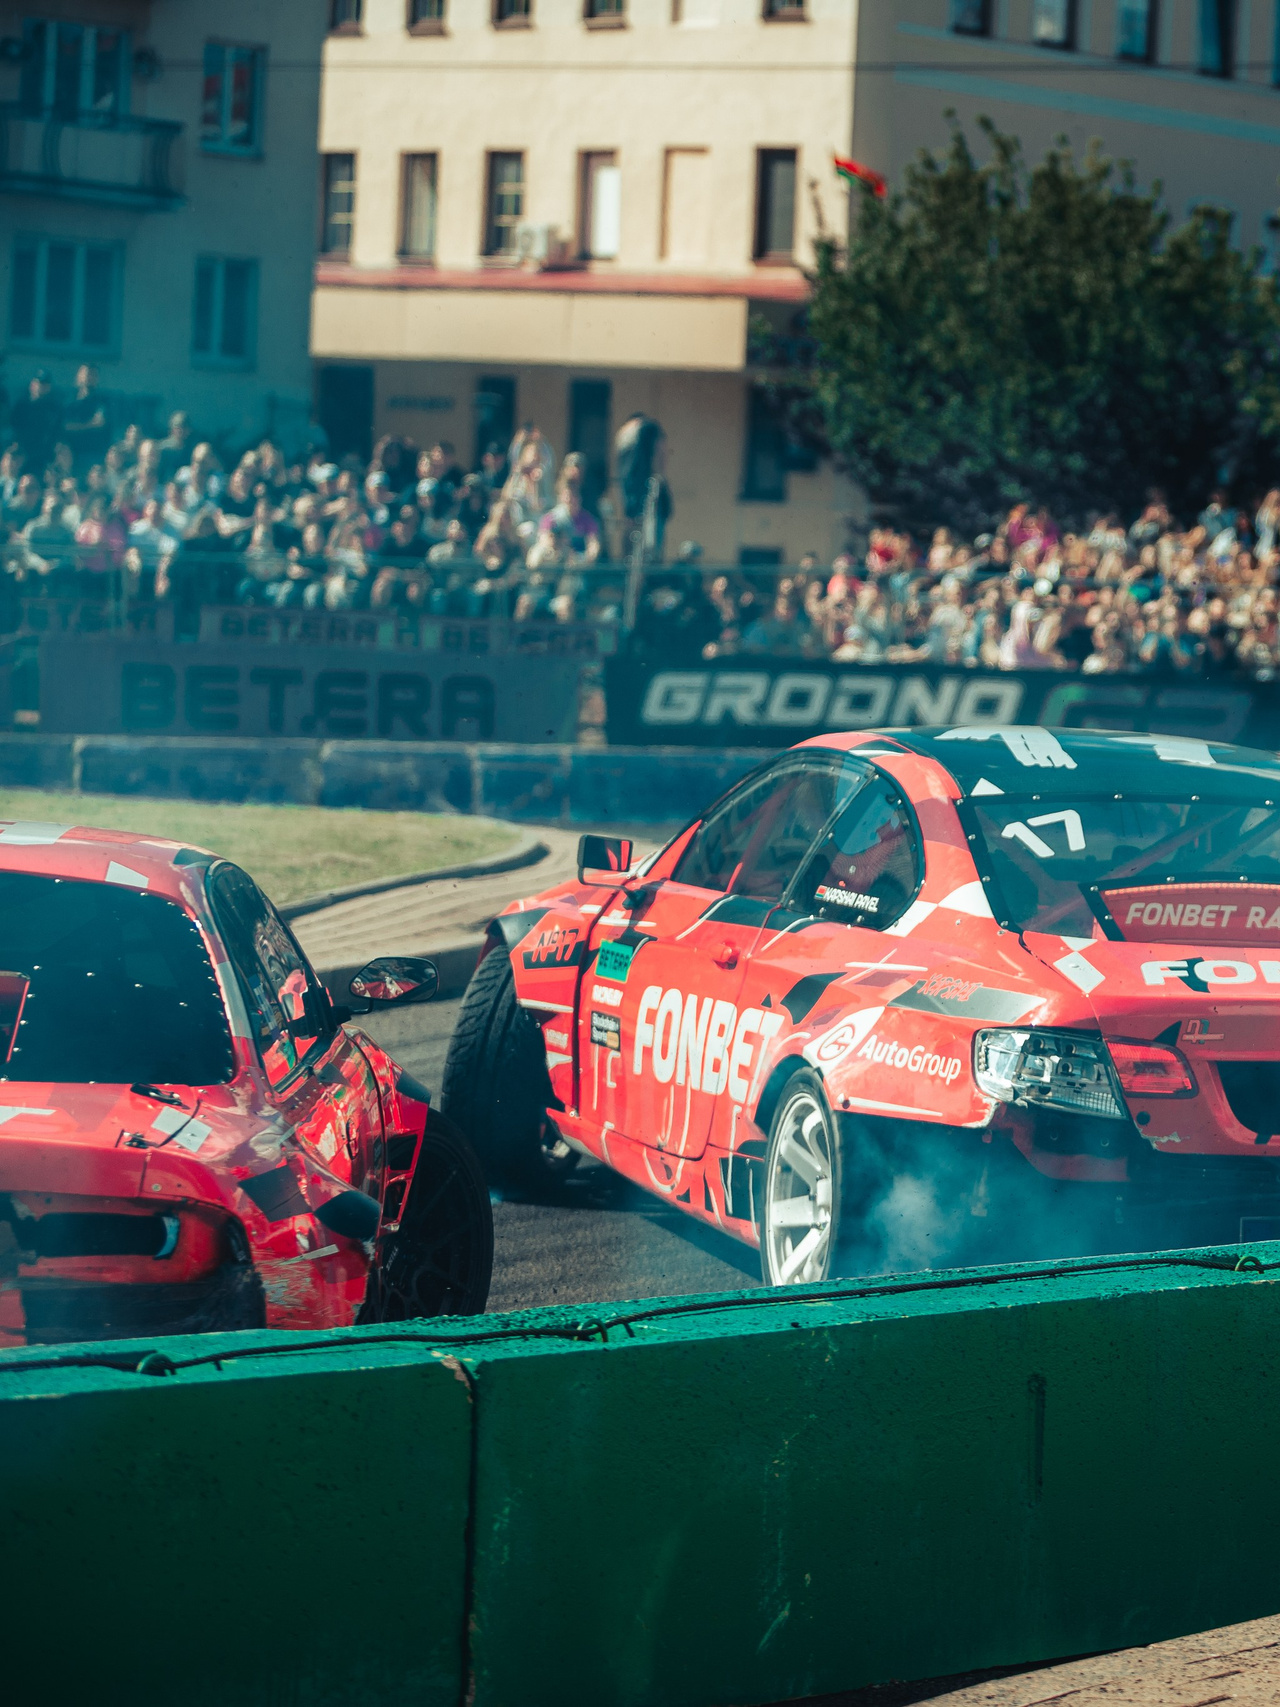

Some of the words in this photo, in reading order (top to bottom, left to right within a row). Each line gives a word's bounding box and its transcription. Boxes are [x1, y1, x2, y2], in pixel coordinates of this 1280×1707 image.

[640, 671, 1027, 728] GRODNO
[1001, 809, 1086, 858] 17
[1125, 902, 1238, 928] FONBET
[633, 985, 785, 1106] FONBET
[856, 1034, 962, 1085] AutoGroup
